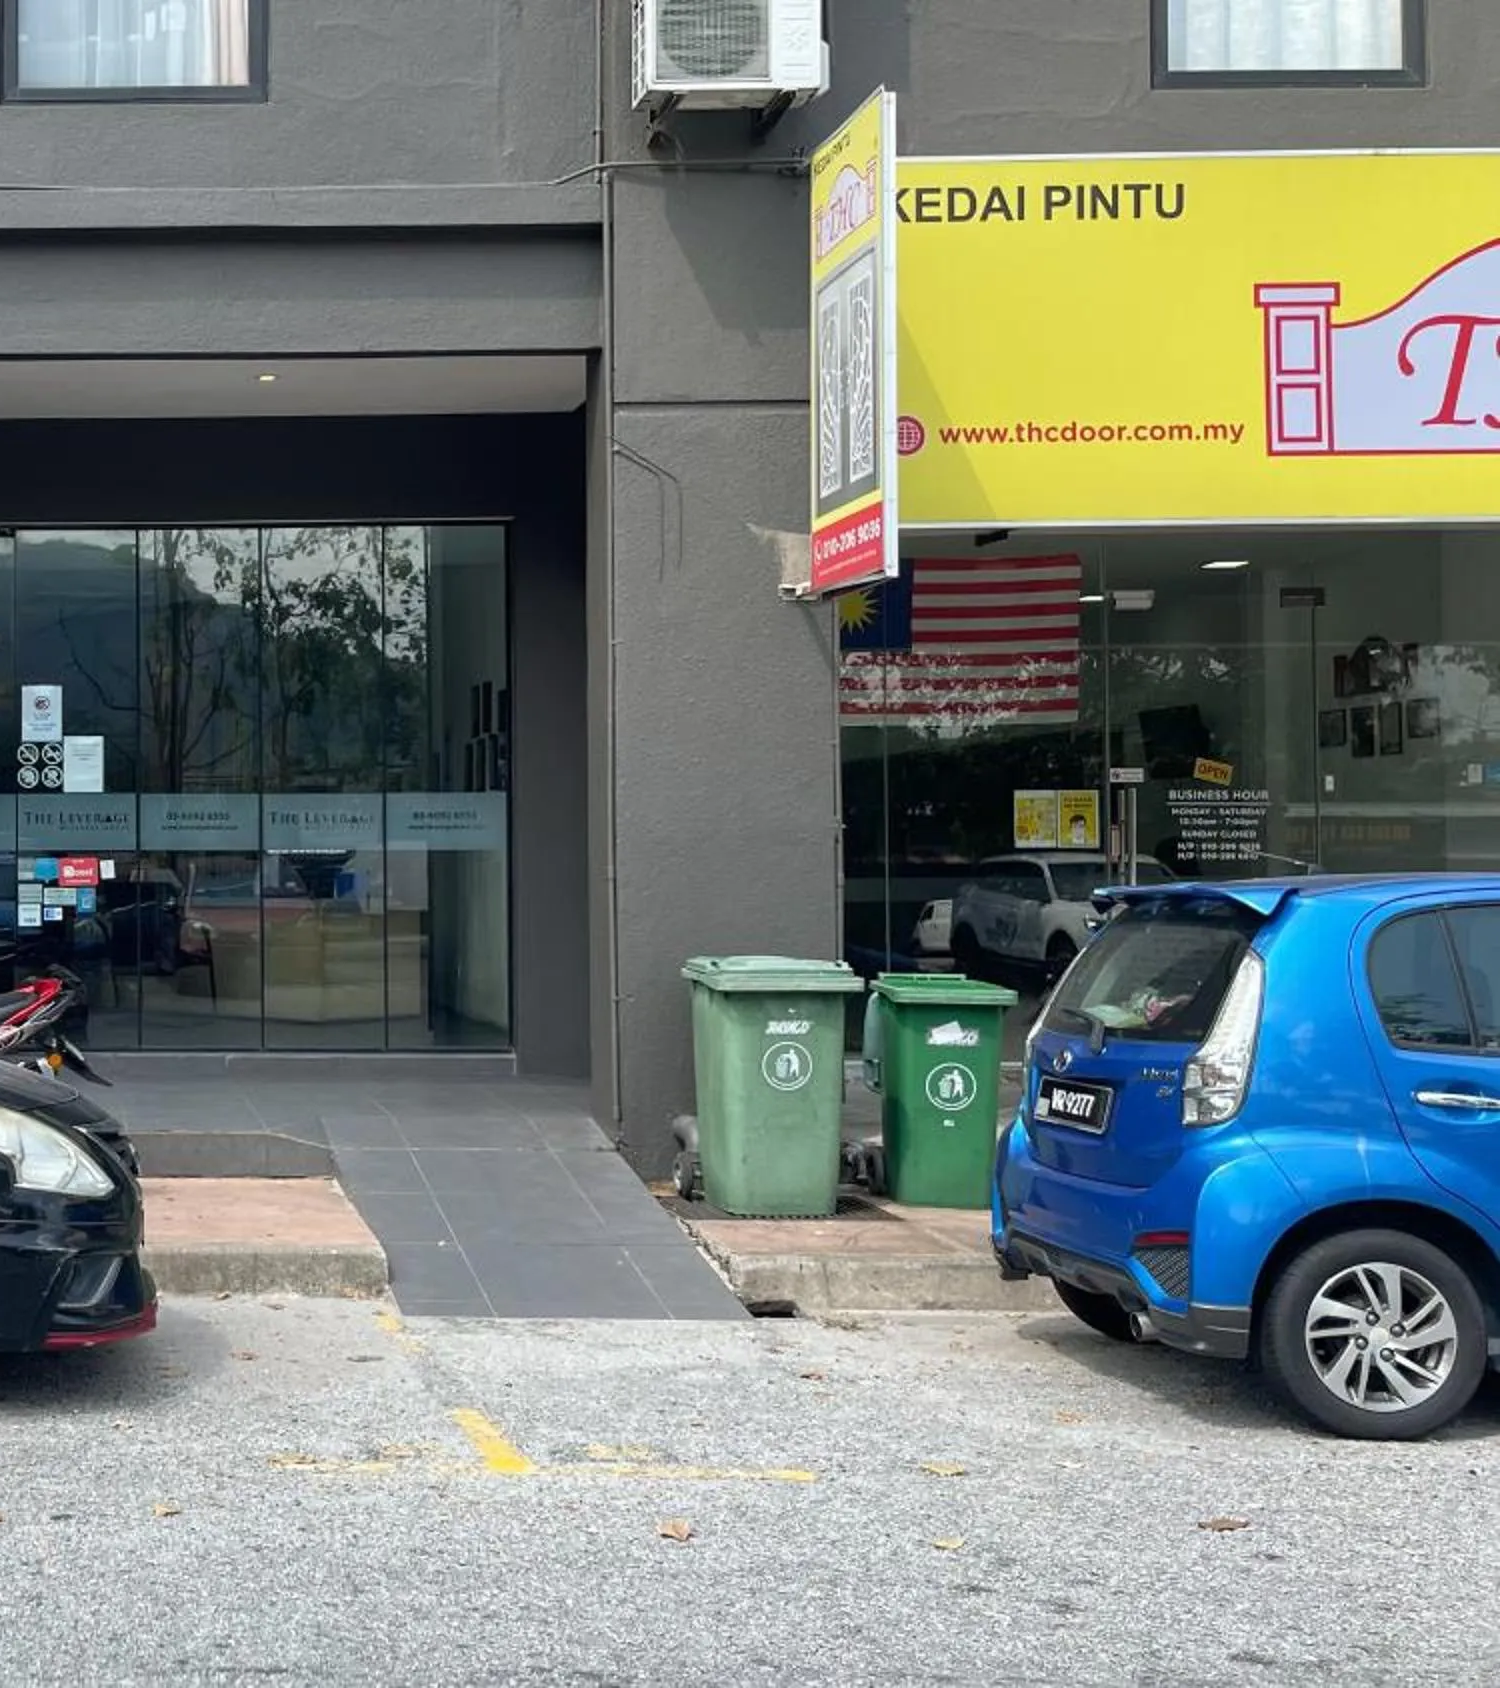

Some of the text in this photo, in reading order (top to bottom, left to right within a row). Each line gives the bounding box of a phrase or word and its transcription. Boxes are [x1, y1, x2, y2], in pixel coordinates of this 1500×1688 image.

[1043, 184, 1185, 221] PINTU
[1398, 315, 1500, 429] T
[939, 421, 1245, 445] www.thcdoor.com.my
[1197, 763, 1229, 779] OPEN
[1168, 789, 1270, 800] BUSINESS HOUR
[24, 811, 55, 826] THE
[1171, 807, 1211, 816] MONDAY
[1219, 807, 1267, 816] SATURDAY
